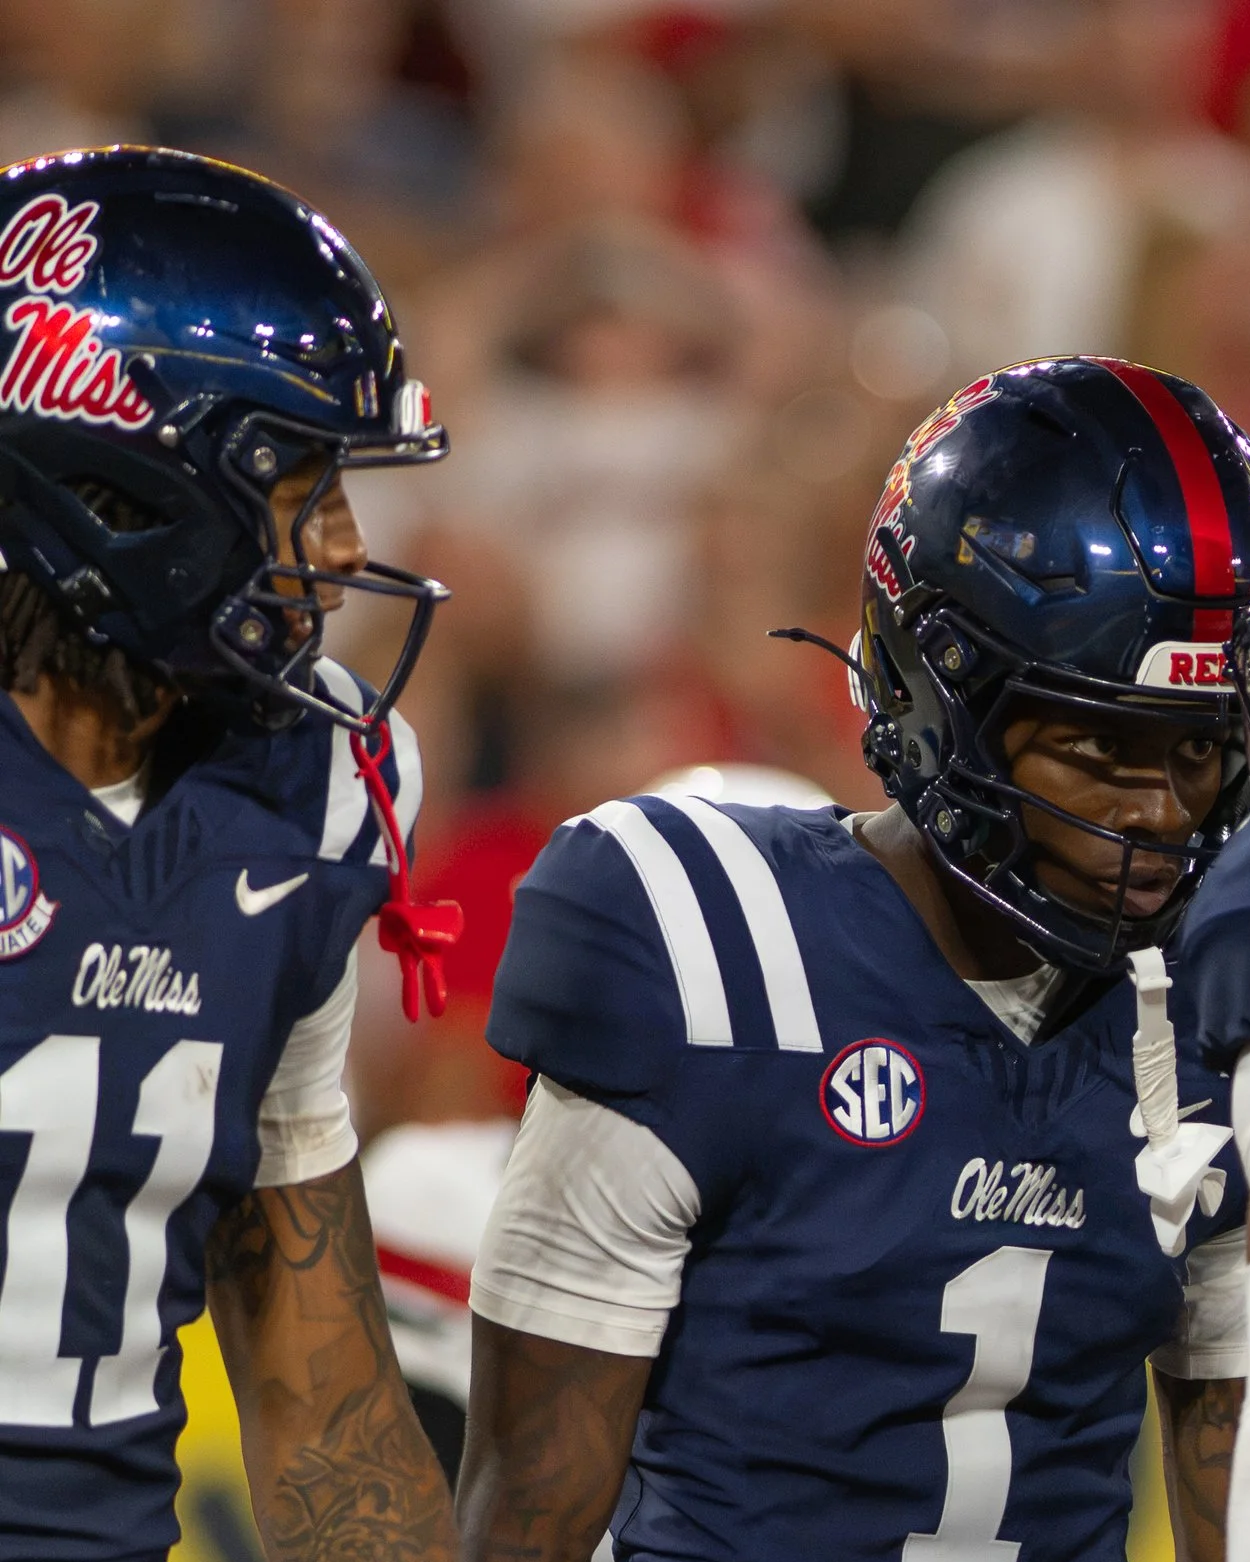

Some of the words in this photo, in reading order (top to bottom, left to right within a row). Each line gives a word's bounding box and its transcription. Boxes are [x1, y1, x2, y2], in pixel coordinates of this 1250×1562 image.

[0, 193, 98, 294] Ole
[0, 296, 154, 430] Miss
[830, 1046, 917, 1139] SEC
[0, 1034, 224, 1429] 11
